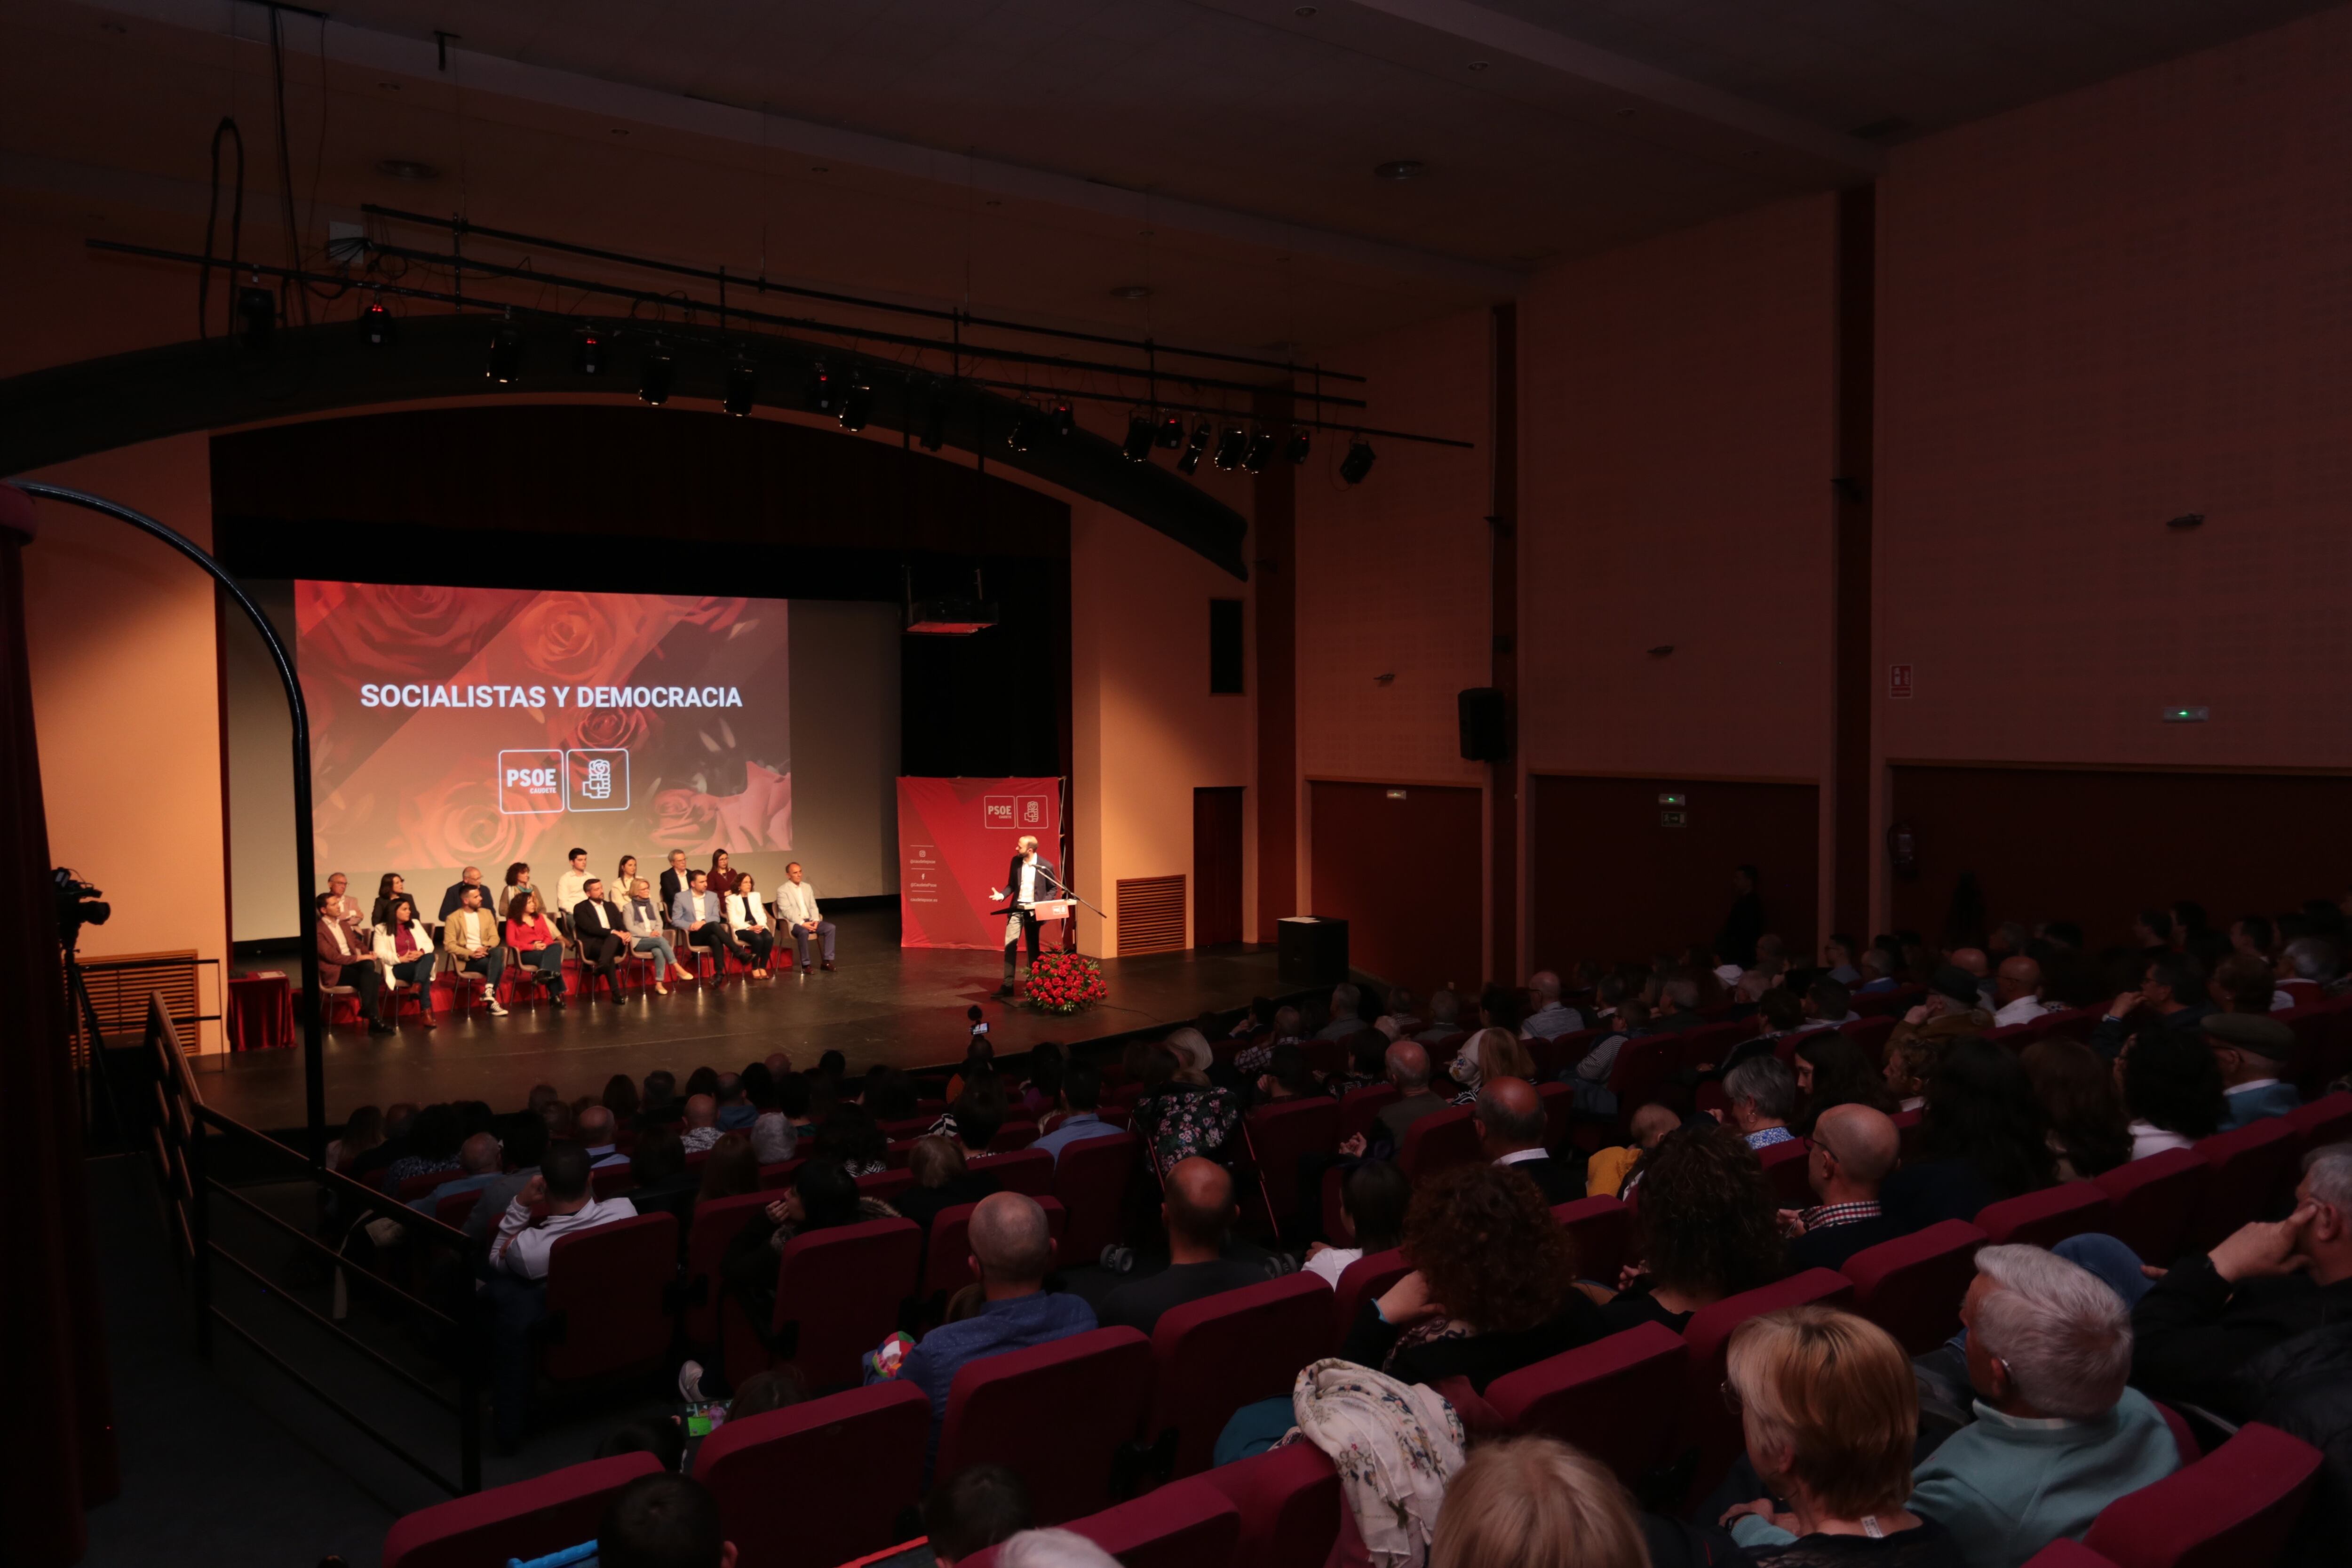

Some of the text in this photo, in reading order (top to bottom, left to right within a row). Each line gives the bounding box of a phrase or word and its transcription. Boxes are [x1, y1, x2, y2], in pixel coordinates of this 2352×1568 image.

[361, 684, 743, 708] SOCIALISTAS Y DEMOCRACIA
[507, 768, 556, 788] PSOE
[988, 805, 1012, 815] PSOE
